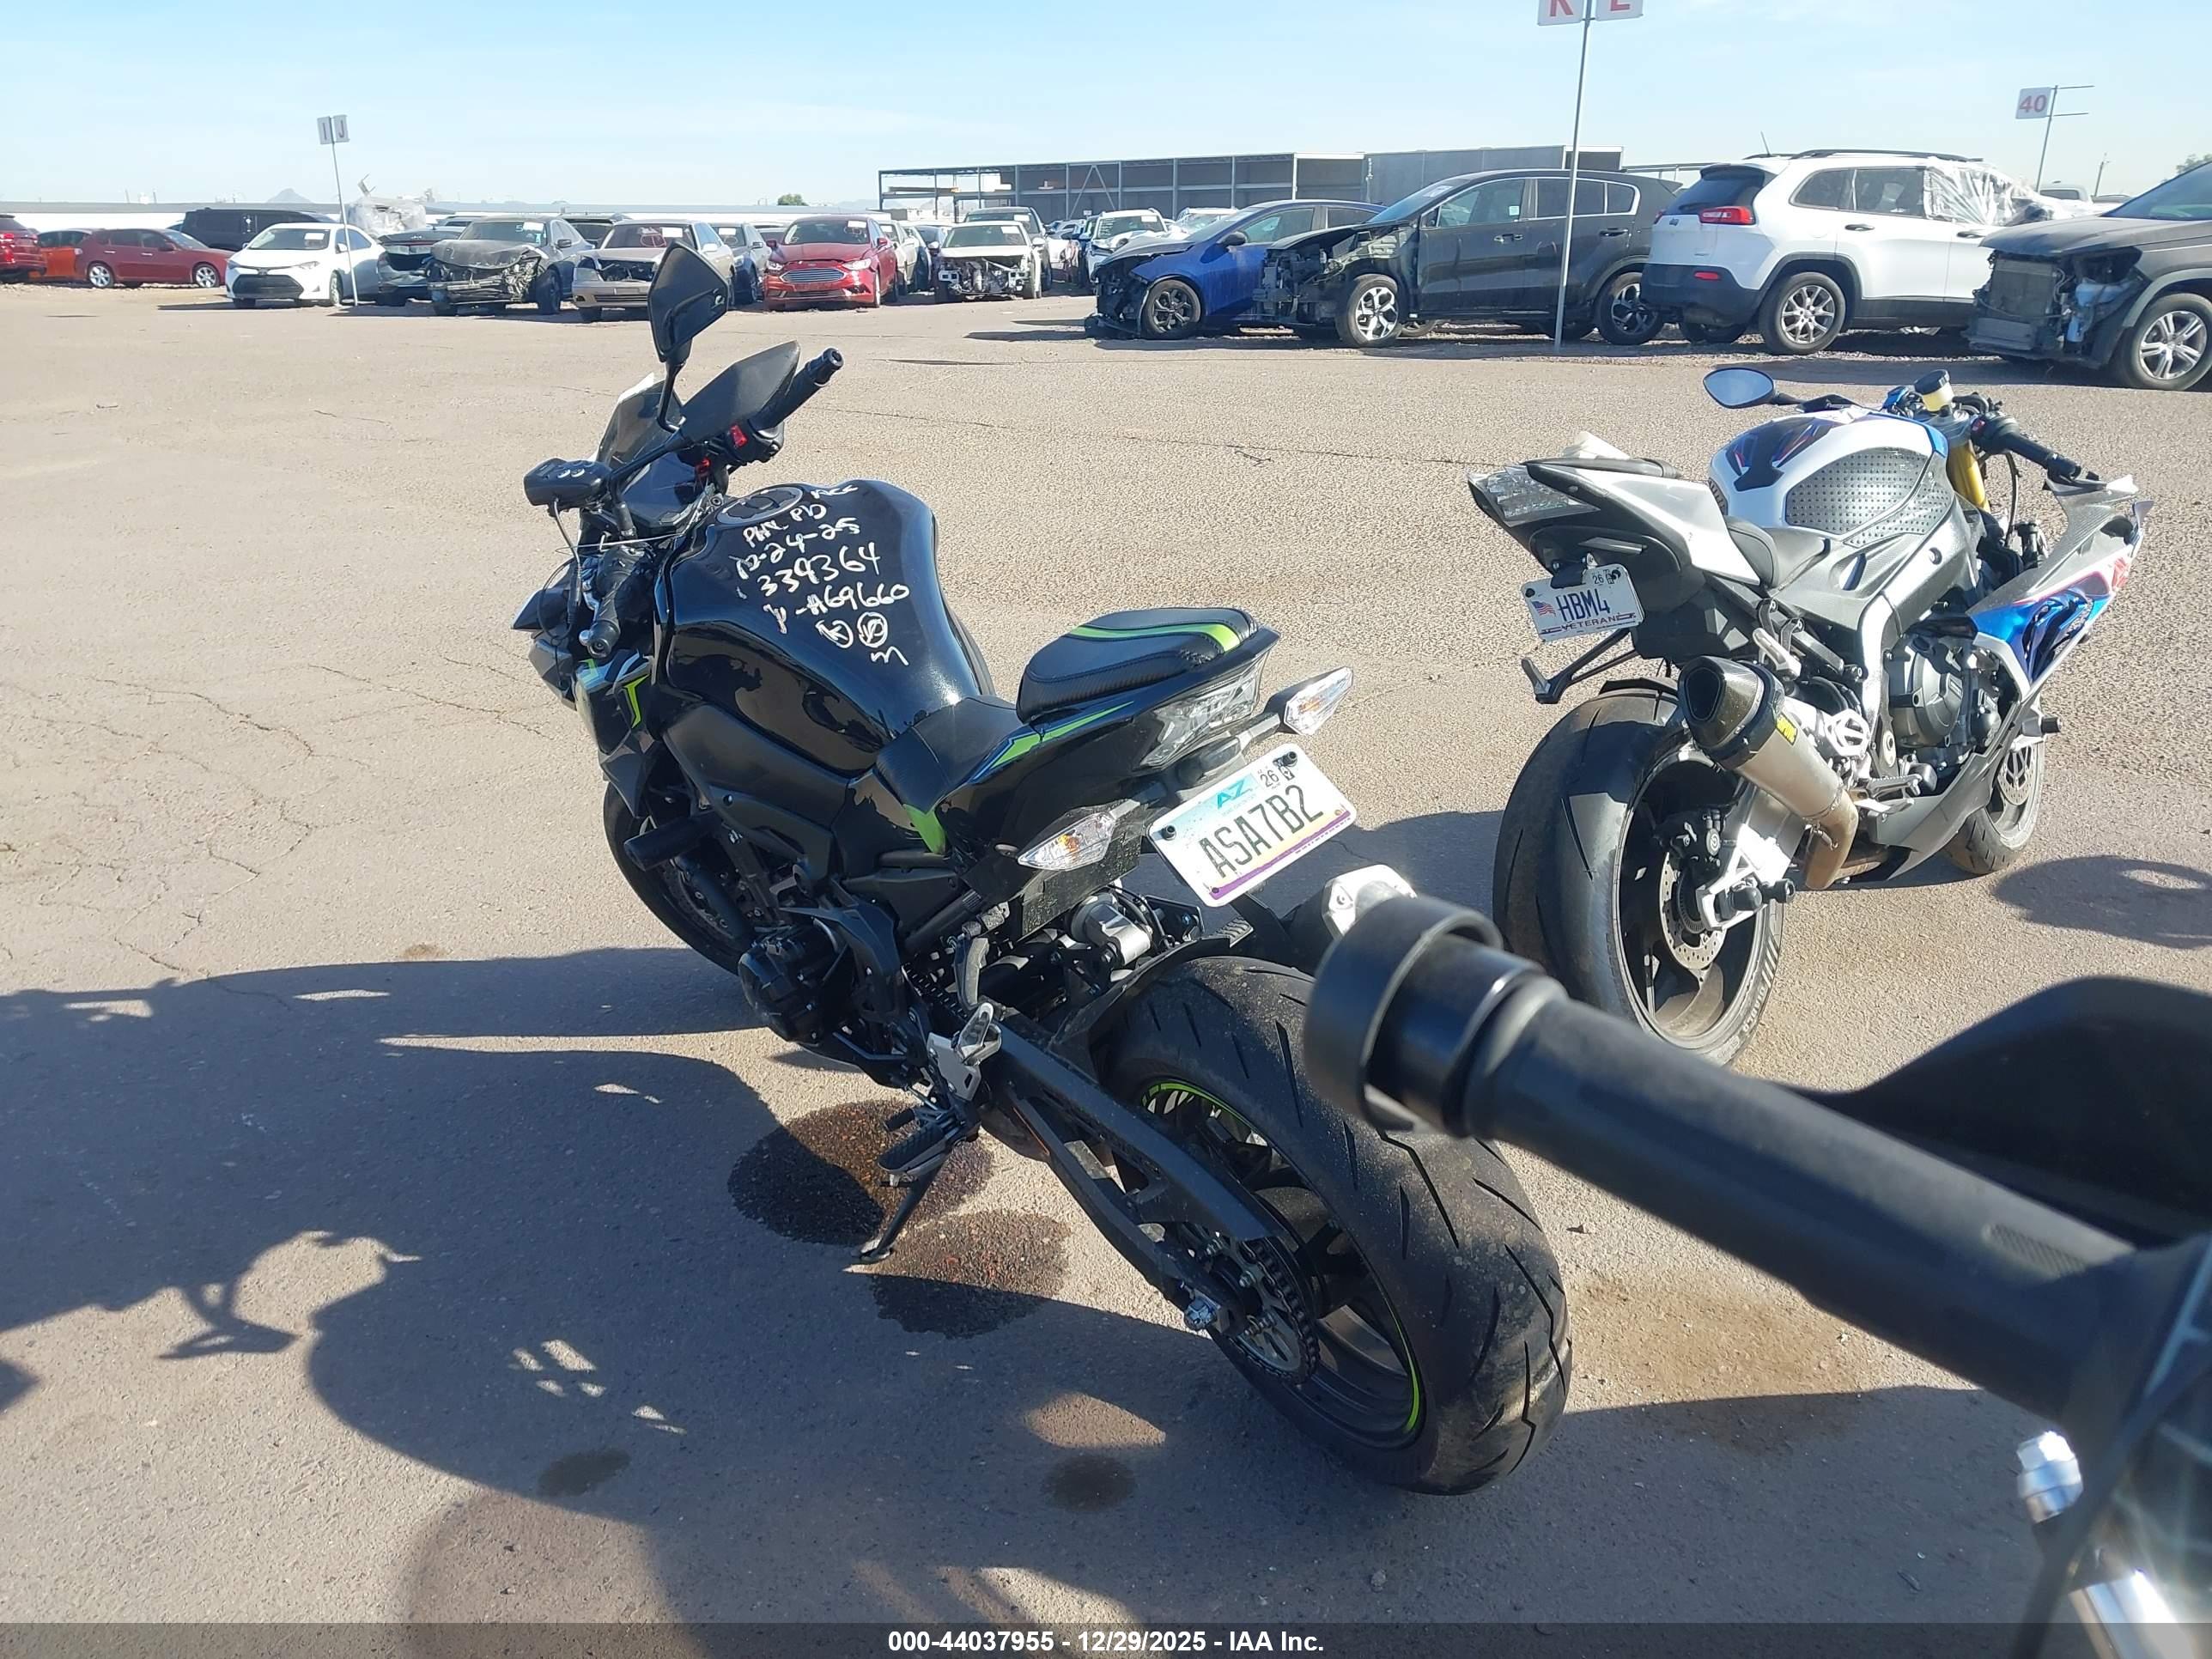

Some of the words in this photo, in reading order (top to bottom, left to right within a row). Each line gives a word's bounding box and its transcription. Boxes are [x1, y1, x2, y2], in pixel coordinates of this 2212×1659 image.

[2019, 94, 2047, 112] 40
[338, 119, 345, 138] J
[757, 542, 881, 597] 339364
[1593, 574, 1604, 585] 26
[1555, 588, 1611, 622] HBM4
[1561, 615, 1617, 632] VETERAN
[1260, 769, 1279, 788] 26
[1217, 779, 1244, 810] AZ
[1198, 784, 1324, 878] ASA7B2
